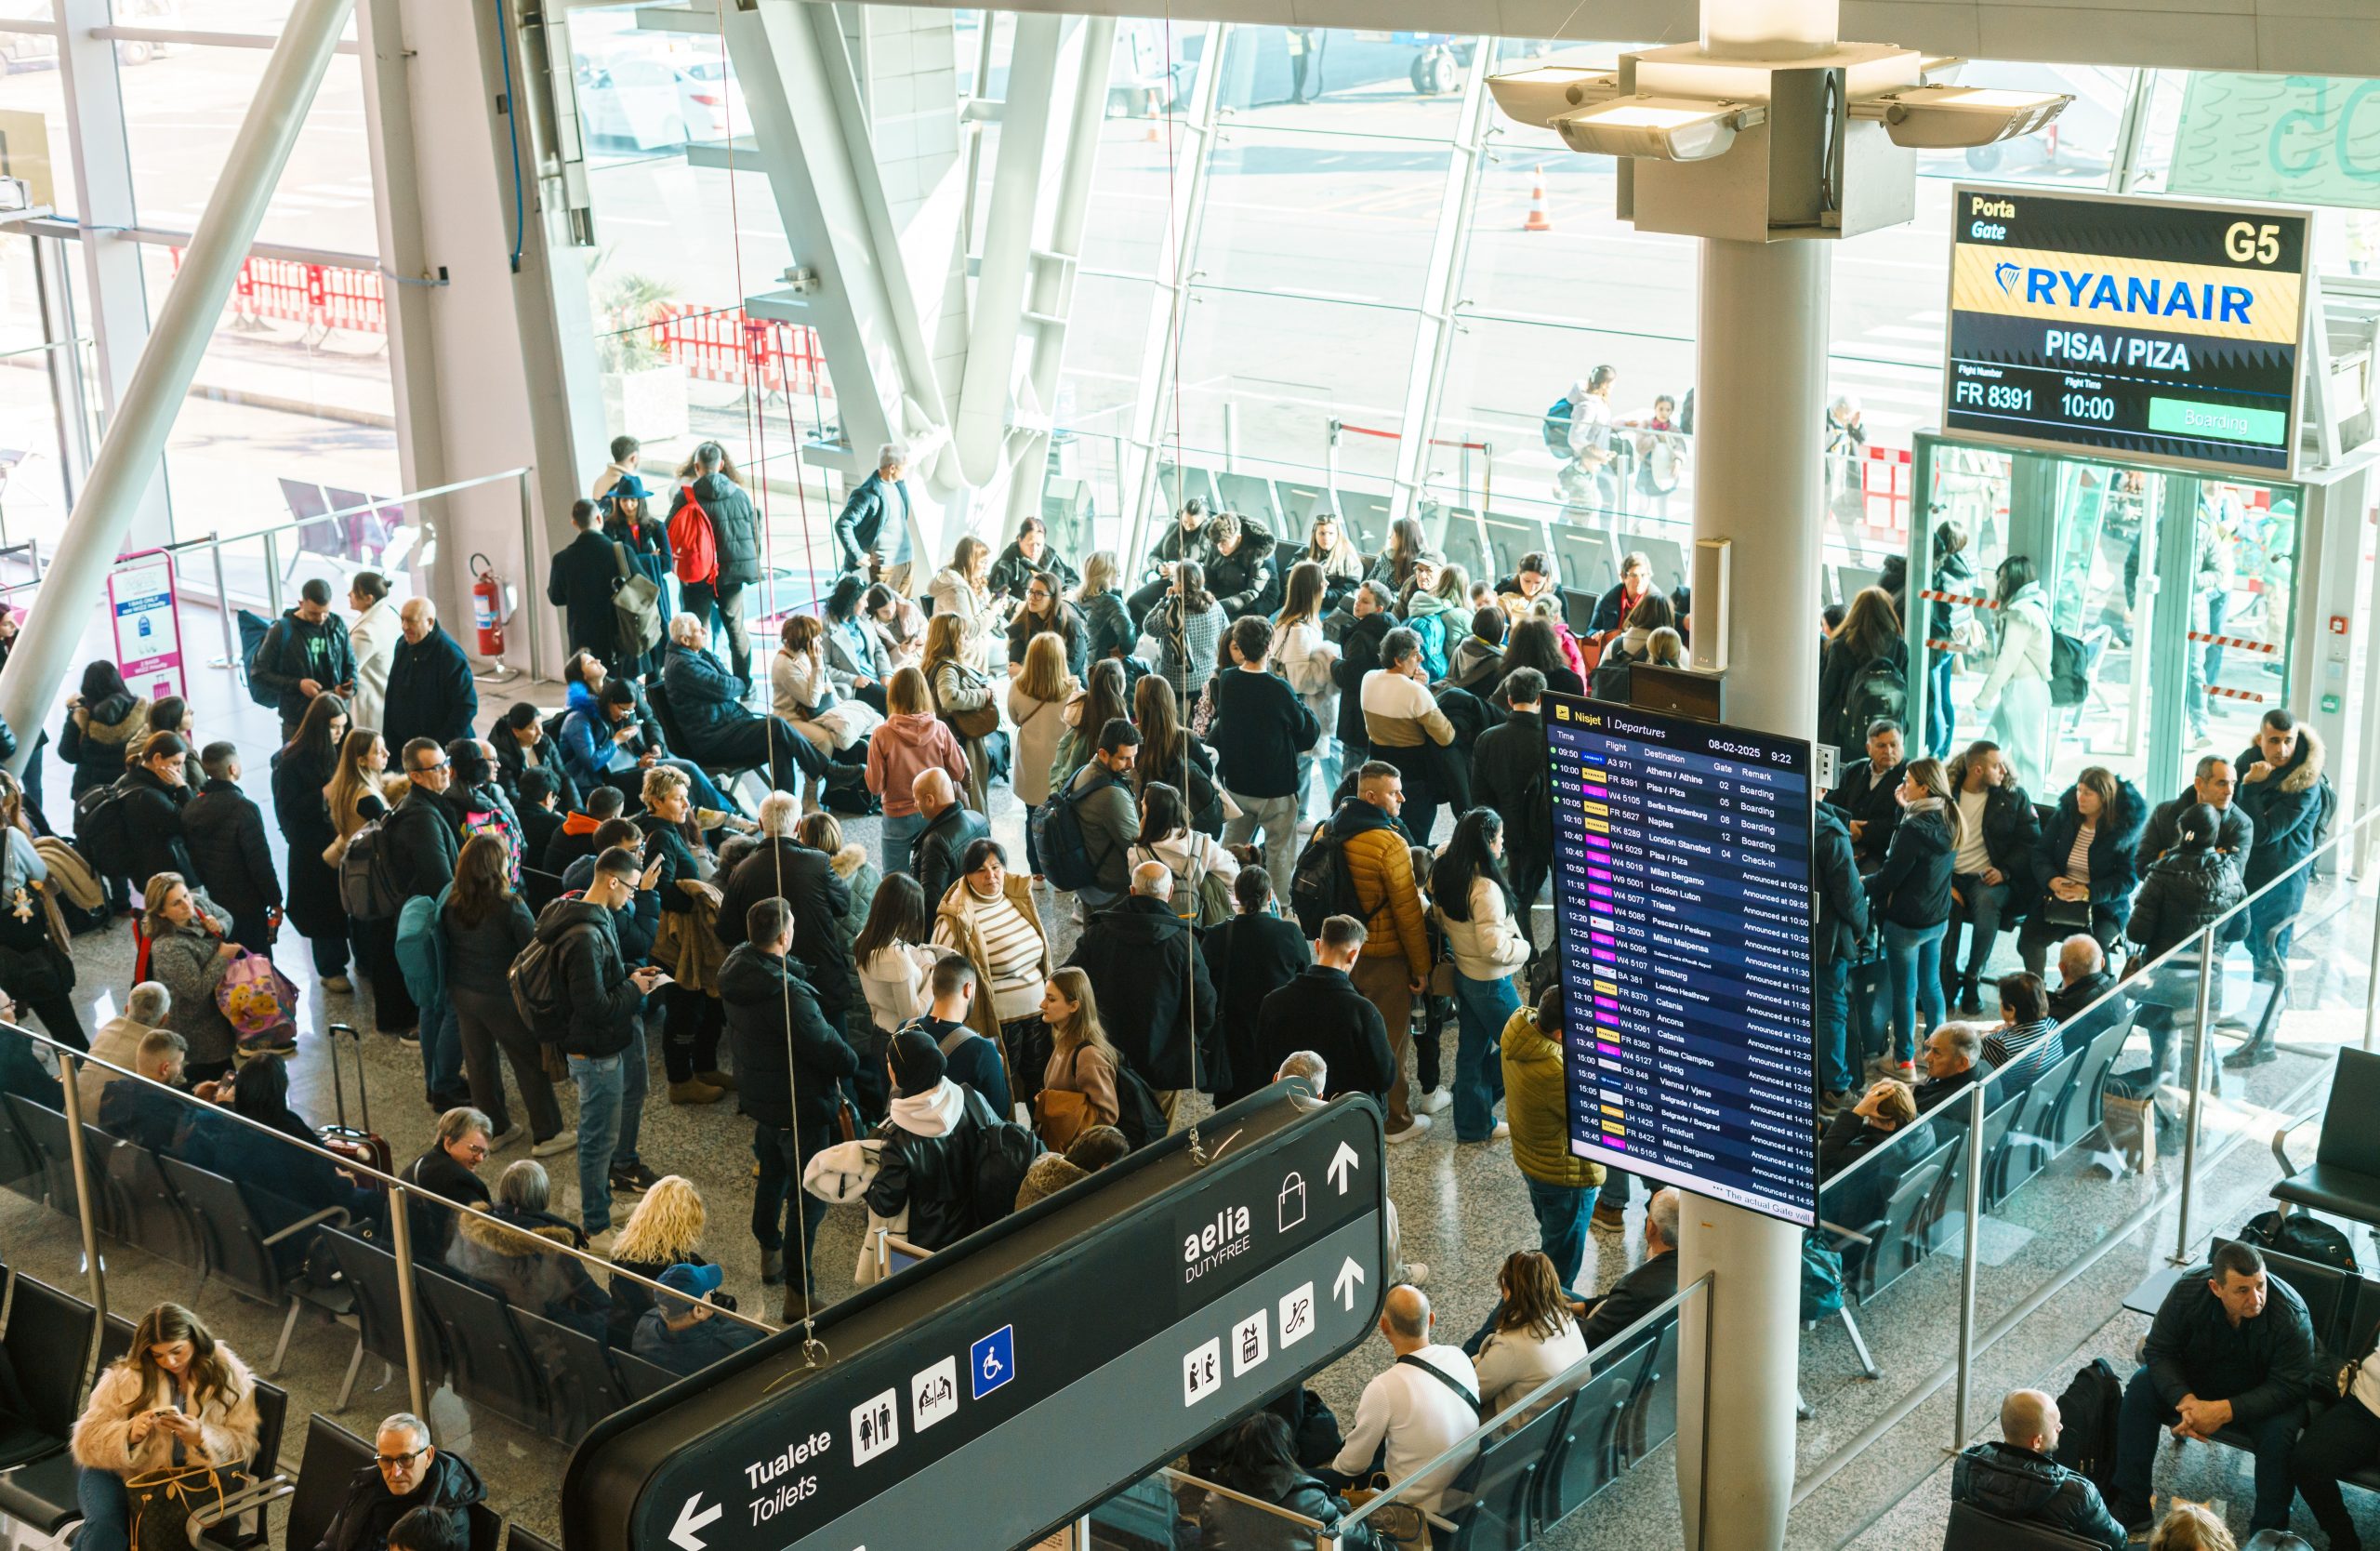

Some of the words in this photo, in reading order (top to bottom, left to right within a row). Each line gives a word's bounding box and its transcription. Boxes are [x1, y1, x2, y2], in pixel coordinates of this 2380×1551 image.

[1972, 197, 2016, 219] Porta
[1972, 220, 2006, 240] Gate
[2225, 221, 2280, 264] G5
[2027, 268, 2254, 325] RYANAIR
[2046, 330, 2107, 363] PISA
[2128, 338, 2189, 371] PIZA
[1959, 365, 1977, 376] Flight
[1977, 367, 2003, 378] Number
[2066, 377, 2083, 389] Flight
[2084, 379, 2101, 390] Time
[1957, 381, 1983, 405] FR
[1988, 386, 2031, 411] 8391
[2062, 394, 2114, 420] 10:00
[2185, 409, 2248, 434] Boarding
[1575, 711, 1601, 726] Nisjet
[1614, 719, 1665, 738] Departures
[1557, 731, 1575, 741] Time
[1606, 740, 1627, 752] Flight
[1645, 749, 1686, 763] Destination
[1713, 762, 1733, 774] Gate
[1742, 768, 1772, 781] Remark
[1709, 739, 1761, 758] 08-02-2025
[1771, 751, 1792, 764] 9:22
[1558, 748, 1579, 759] 09:50
[1607, 758, 1618, 767] A3
[1619, 761, 1632, 770] 971
[1646, 766, 1673, 778] Athens
[1679, 773, 1703, 785] Athine
[1719, 781, 1729, 790] 02
[1740, 785, 1775, 801] Boarding
[1560, 764, 1580, 776] 10:00
[1608, 775, 1619, 784] FR
[1620, 777, 1638, 788] 8391
[1646, 782, 1663, 793] Pisa
[1669, 788, 1686, 798] Piza
[1720, 798, 1730, 807] 05
[1740, 802, 1775, 818] Boarding
[1561, 781, 1580, 792] 10:00
[1608, 791, 1621, 801] W4
[1622, 794, 1641, 805] 5105
[1647, 801, 1666, 811] Berlin
[1667, 804, 1708, 821] Brandenburg
[1720, 815, 1730, 825] 08
[1741, 819, 1775, 836] Boarding
[1562, 798, 1581, 808] 10:05
[1609, 808, 1620, 817] FR
[1622, 811, 1640, 821] 5627
[1648, 816, 1674, 829] Naples
[1722, 832, 1730, 842] 12
[1741, 837, 1776, 853] Boarding
[1563, 815, 1582, 825] 10:10
[1610, 825, 1622, 834] RK
[1623, 828, 1641, 839] 8289
[1648, 833, 1676, 846] London
[1678, 840, 1711, 855] Stansted
[1721, 850, 1731, 858] 04
[1564, 830, 1583, 842] 10:40
[1611, 842, 1623, 851] W4
[1625, 844, 1643, 855] 5029
[1649, 850, 1666, 861] Pisa
[1672, 855, 1688, 866] Piza
[1565, 847, 1584, 857] 10:45
[1612, 857, 1624, 868] W4
[1626, 861, 1644, 872] 5019
[1650, 867, 1670, 878] Milan
[1672, 871, 1705, 886] Bergamo
[1566, 863, 1585, 874] 10:50
[1612, 874, 1625, 884] W9
[1627, 878, 1644, 888] 5001
[1651, 883, 1678, 896] London
[1680, 890, 1701, 902] Luton
[1568, 895, 1586, 907] 11:45
[1652, 917, 1679, 930] Pescara
[1685, 924, 1711, 937] Peskara
[1569, 912, 1588, 923] 12:20
[1615, 923, 1626, 933] ZB
[1628, 926, 1645, 937] 2003
[1653, 933, 1673, 945] Milan
[1674, 938, 1709, 953] Malpensa
[1571, 944, 1590, 955] 12:40
[1617, 956, 1629, 965] W4
[1631, 960, 1647, 970] 5107
[1655, 965, 1688, 982] Hamburg
[1572, 960, 1591, 971] 12:45
[1618, 972, 1629, 981] BA
[1631, 974, 1643, 985] 381
[1655, 982, 1679, 994] London
[1679, 988, 1710, 1001] Heathrow
[1572, 975, 1592, 987] 12:50
[1619, 988, 1630, 997] FR
[1631, 991, 1648, 1002] 8370
[1656, 998, 1684, 1012] Catania
[1574, 991, 1593, 1002] 13:10
[1619, 1003, 1632, 1014] W4
[1633, 1007, 1650, 1018] 5079
[1657, 1014, 1684, 1027] Ancona
[1576, 1023, 1594, 1034] 13:40
[1659, 1045, 1679, 1057] Rome
[1680, 1052, 1714, 1067] Ciampino
[1577, 1038, 1594, 1049] 13:45
[1621, 1051, 1633, 1060] W4
[1635, 1054, 1652, 1066] 5127
[1659, 1061, 1685, 1076] Leipzig
[1578, 1054, 1595, 1065] 15:00
[1659, 1077, 1685, 1091] Vienna
[1690, 1086, 1712, 1098] Vjene
[1578, 1069, 1596, 1080] 15:05
[1623, 1082, 1633, 1091] JU
[1635, 1086, 1647, 1095] 163
[1660, 1094, 1688, 1107] Belgrade
[1693, 1103, 1720, 1116] Beograd
[1580, 1100, 1598, 1111] 15:40
[1662, 1124, 1694, 1140] Frankfurt
[1580, 1115, 1599, 1126] 15:45
[1626, 1128, 1636, 1137] FR
[1638, 1132, 1655, 1143] 8422
[1663, 1139, 1682, 1151] Milan
[1683, 1145, 1715, 1160] Bergamo
[1581, 1131, 1600, 1141] 15:45
[1663, 1155, 1693, 1170] Valencia
[1726, 1189, 1742, 1201] The
[1745, 1199, 1770, 1210] actual
[1772, 1204, 1793, 1217] Gate
[1795, 1213, 1810, 1223] will
[1184, 1206, 1250, 1263] aelia
[1185, 1234, 1250, 1284] DUTYFREE
[746, 1431, 831, 1490] Tualete
[748, 1475, 817, 1527] Toilets
